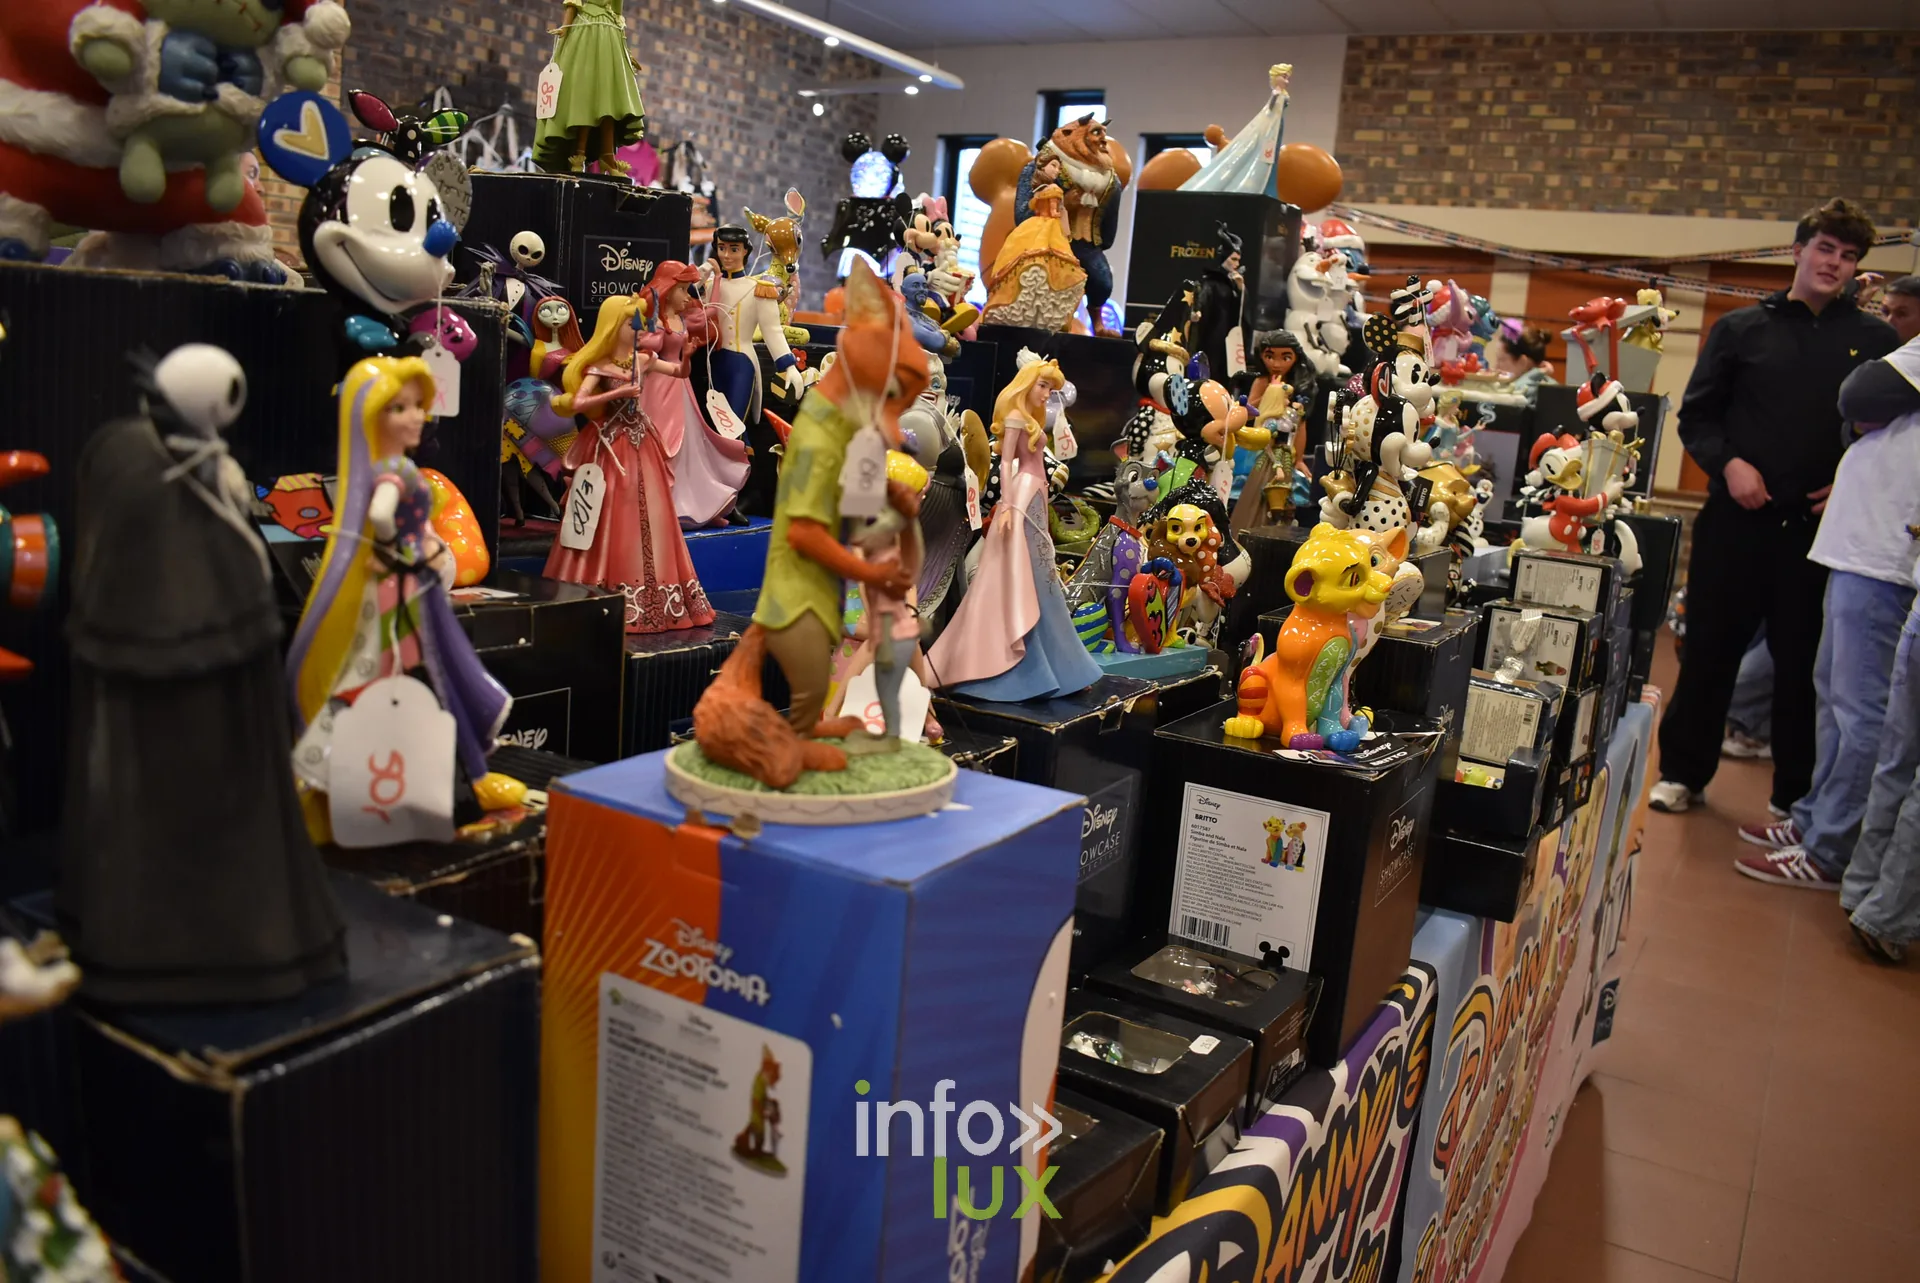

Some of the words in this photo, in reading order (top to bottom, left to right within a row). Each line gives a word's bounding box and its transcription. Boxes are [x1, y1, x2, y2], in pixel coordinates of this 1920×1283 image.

[1170, 245, 1216, 259] FROZEN
[591, 280, 646, 295] SHOWC
[1418, 487, 1428, 507] BRITTO
[1369, 751, 1408, 767] BRITTO
[1195, 793, 1222, 811] Disney
[1080, 803, 1119, 840] Disney
[1194, 812, 1218, 825] BRITTO
[1190, 828, 1204, 836] Simba
[1080, 831, 1121, 866] OWCASE
[1189, 834, 1208, 844] Figurine
[1215, 840, 1230, 848] Simba
